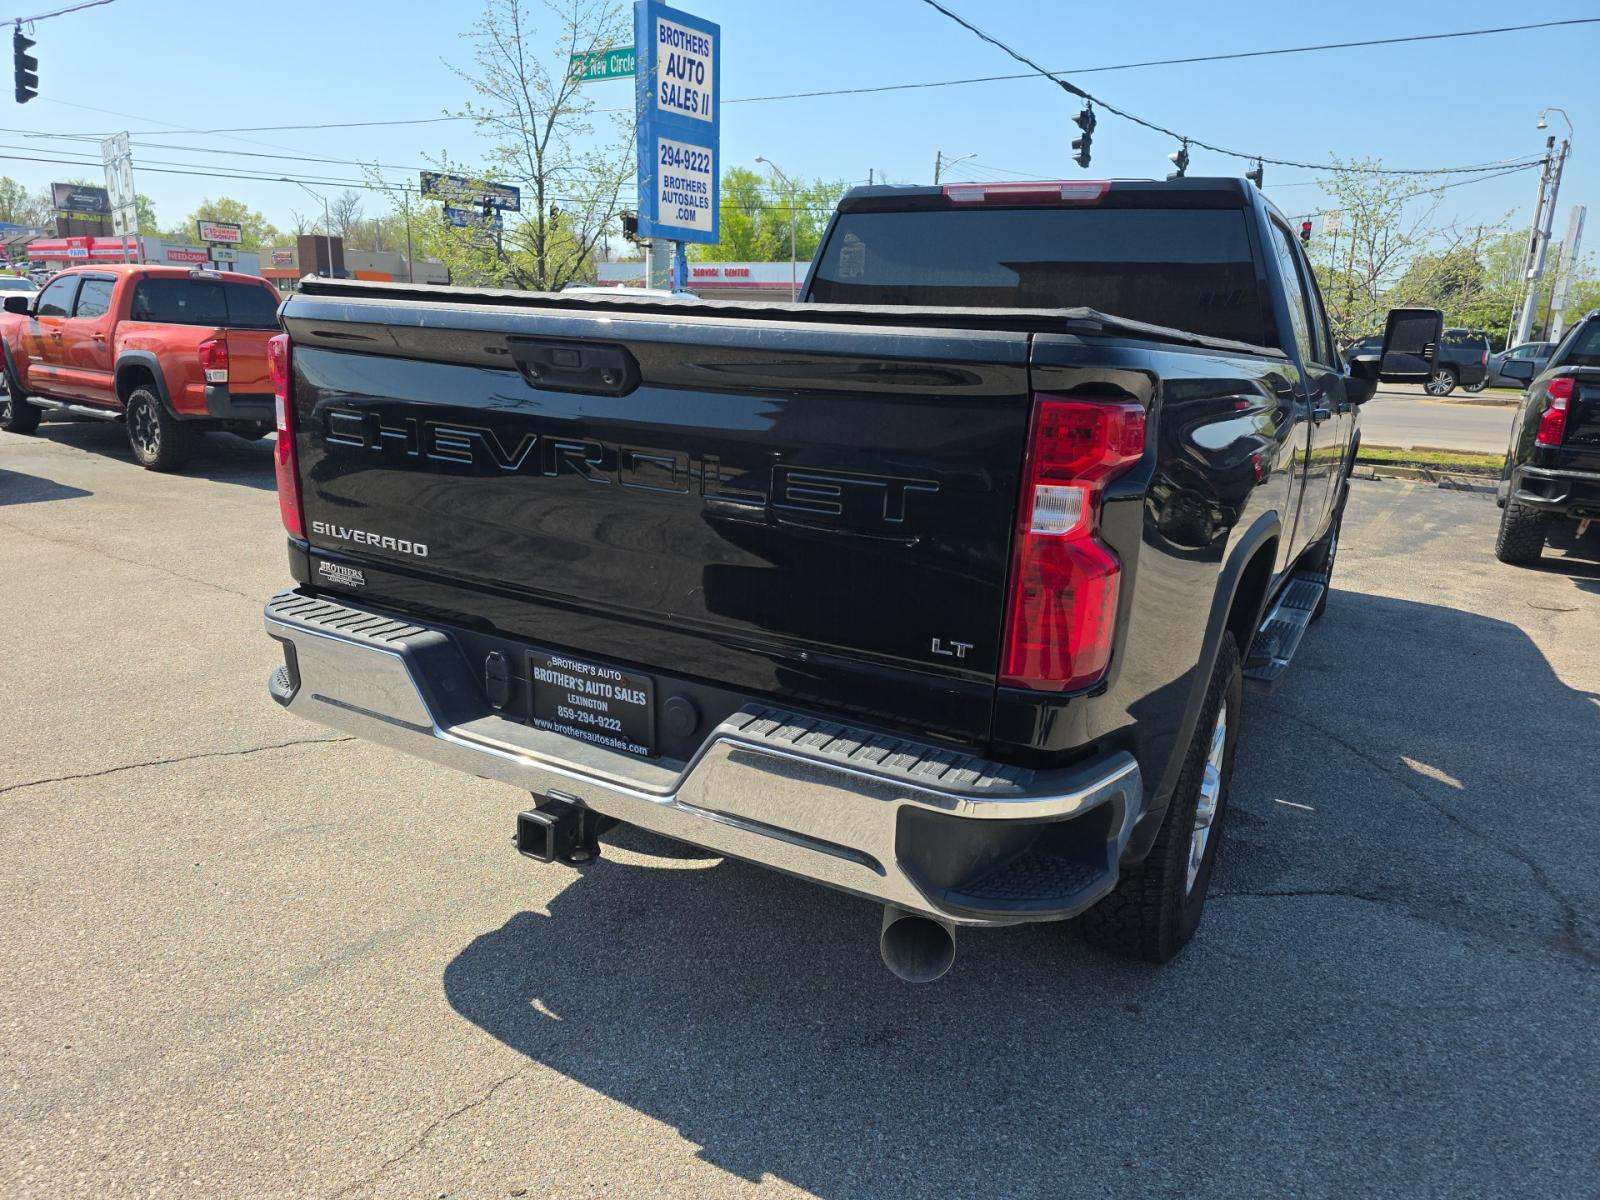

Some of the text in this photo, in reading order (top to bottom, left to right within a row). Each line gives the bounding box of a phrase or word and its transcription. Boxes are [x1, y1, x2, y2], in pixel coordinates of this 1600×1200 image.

[659, 24, 710, 58] BROTHERS
[590, 60, 607, 76] New
[610, 53, 635, 73] Circle
[666, 52, 705, 85] AUTO
[661, 81, 699, 112] SALES
[660, 144, 710, 174] 294-9222
[663, 175, 707, 195] BROTHERS
[661, 189, 709, 210] AUTOSALES
[675, 208, 696, 222] .COM
[326, 409, 940, 524] CHEVROLET
[312, 520, 429, 558] SILVERADO
[319, 561, 363, 580] BROTHERS
[931, 637, 974, 658] LT
[551, 656, 622, 681] BROTHER'S AUTO
[533, 666, 647, 706] BROTHER'S AUTO SALES
[567, 693, 609, 712] LEXINGTON
[557, 705, 622, 732] 859-294-9222
[533, 717, 648, 756] www.brothersautosales.com
